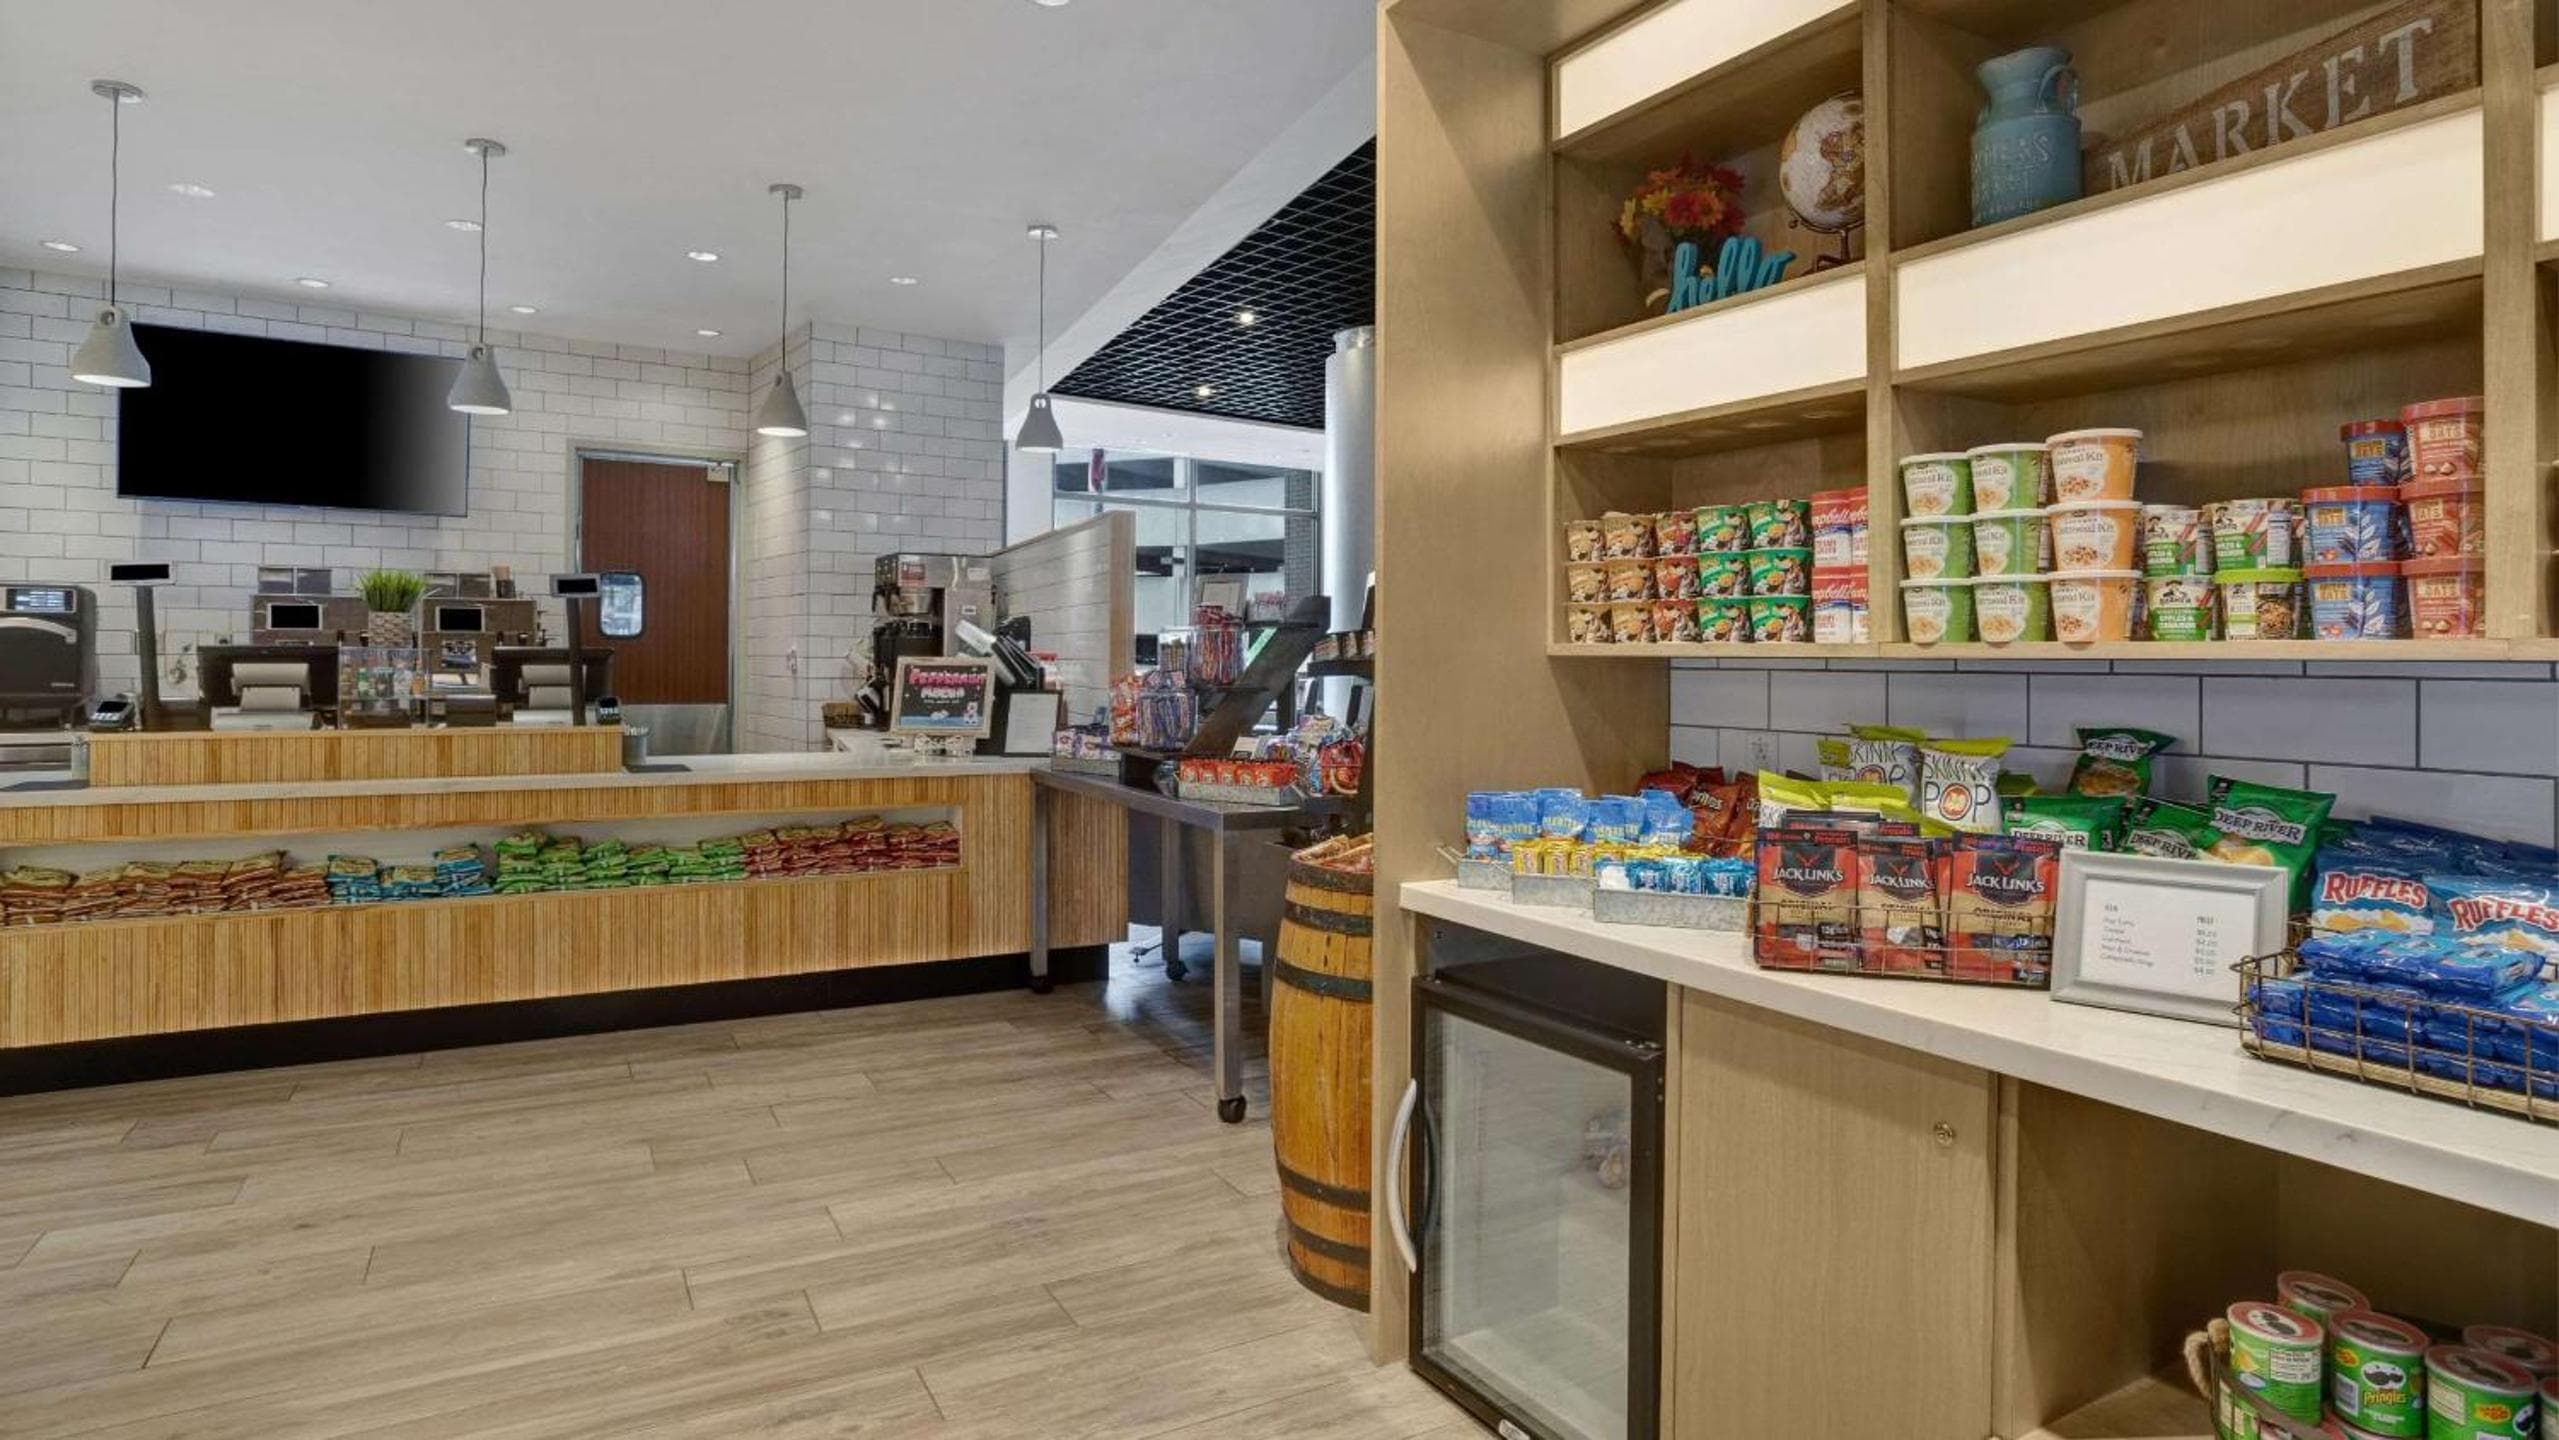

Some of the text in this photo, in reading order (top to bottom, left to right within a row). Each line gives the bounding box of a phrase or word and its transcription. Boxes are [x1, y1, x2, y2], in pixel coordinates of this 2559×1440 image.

[2108, 18, 2434, 191] MARKET
[1667, 235, 1797, 314] hello
[1923, 781, 1992, 823] POP
[2254, 818, 2301, 840] RIVER
[1773, 866, 1844, 883] JACK LINK'S
[1870, 873, 1899, 888] JACK
[1967, 873, 2045, 894] JACK LINK'S
[2322, 871, 2429, 910] RUFFLES
[2447, 896, 2559, 933] RUFFLES
[2363, 1390, 2408, 1408] Pringles
